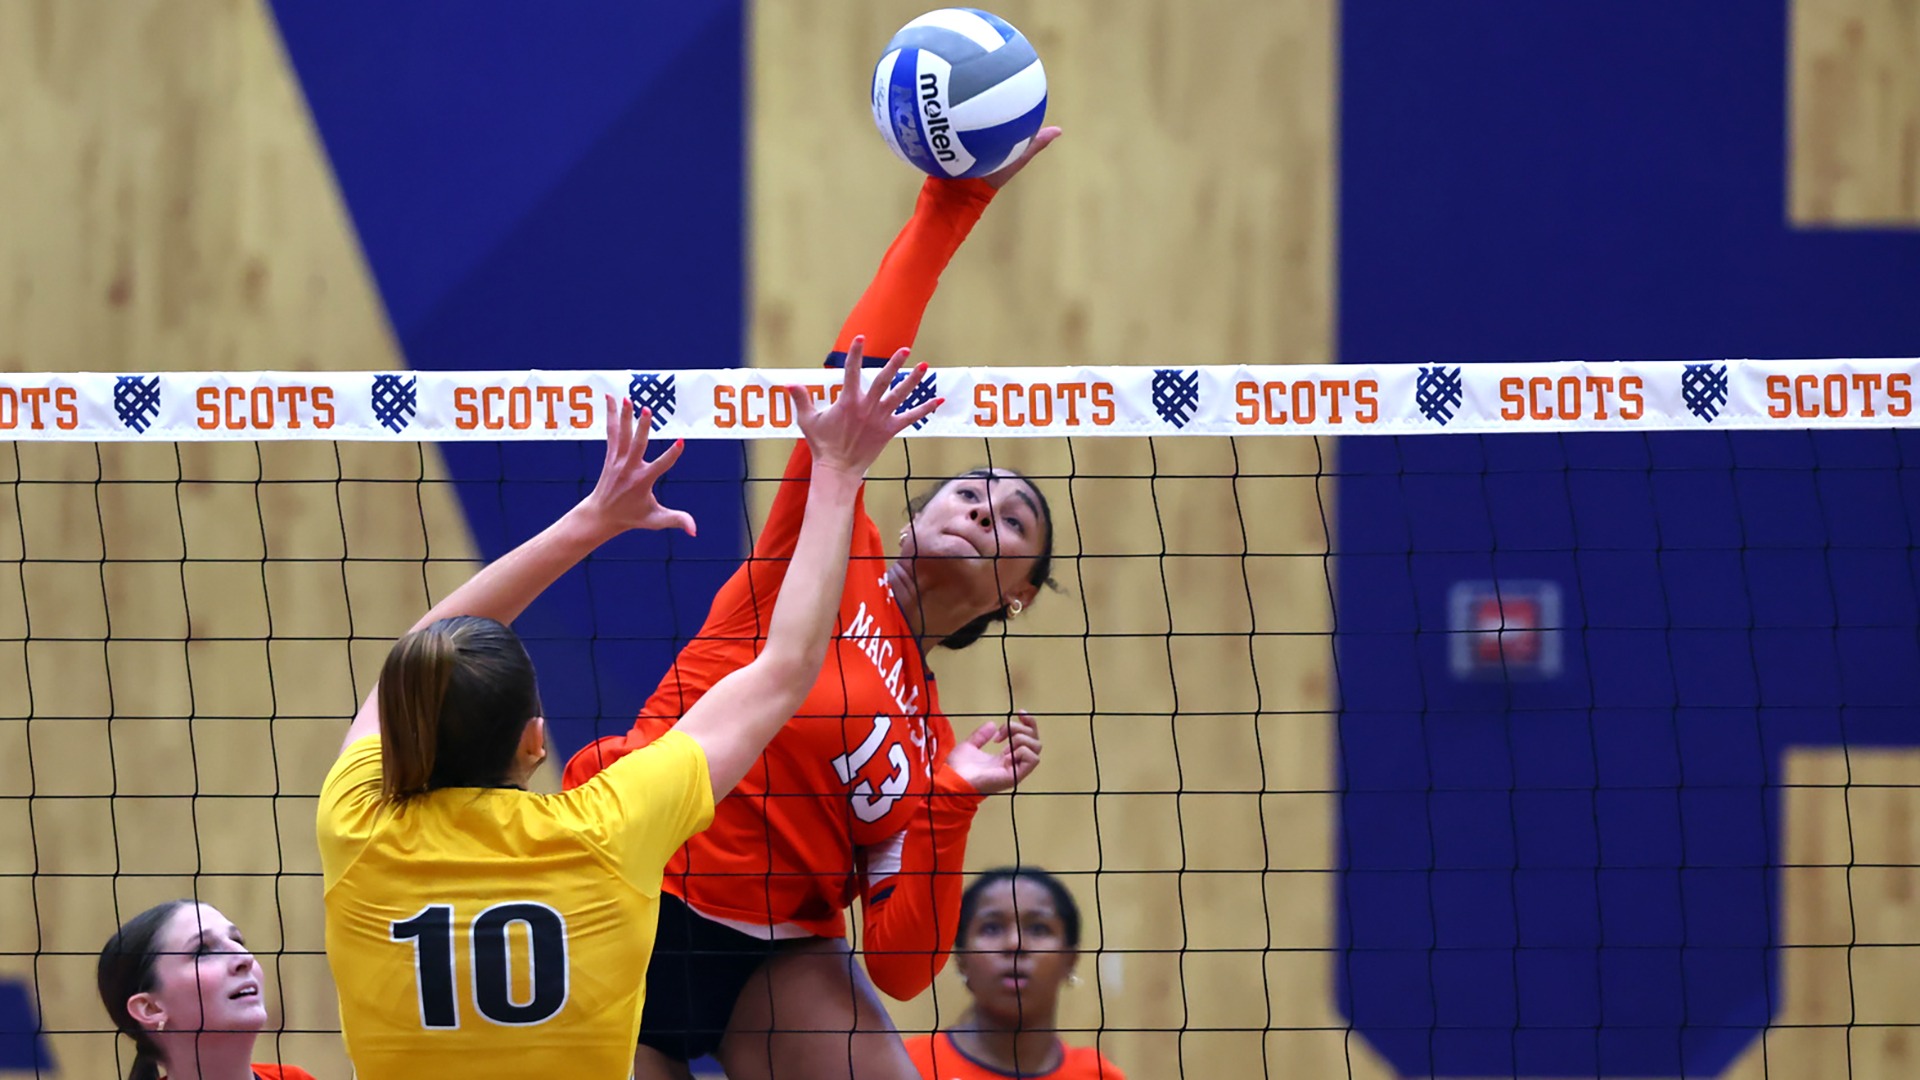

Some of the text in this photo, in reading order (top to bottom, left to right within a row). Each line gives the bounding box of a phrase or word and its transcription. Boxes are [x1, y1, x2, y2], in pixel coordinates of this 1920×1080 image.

[920, 73, 956, 162] molten
[196, 386, 335, 430] SCOTS
[454, 385, 593, 430] SCOTS
[714, 385, 845, 428] SCO
[974, 382, 1115, 427] SCOTS
[1236, 380, 1378, 425] SCOTS
[1500, 376, 1643, 421] SCOTS
[1767, 373, 1912, 419] SCOTS
[831, 712, 910, 823] 13
[389, 901, 569, 1029] 10
